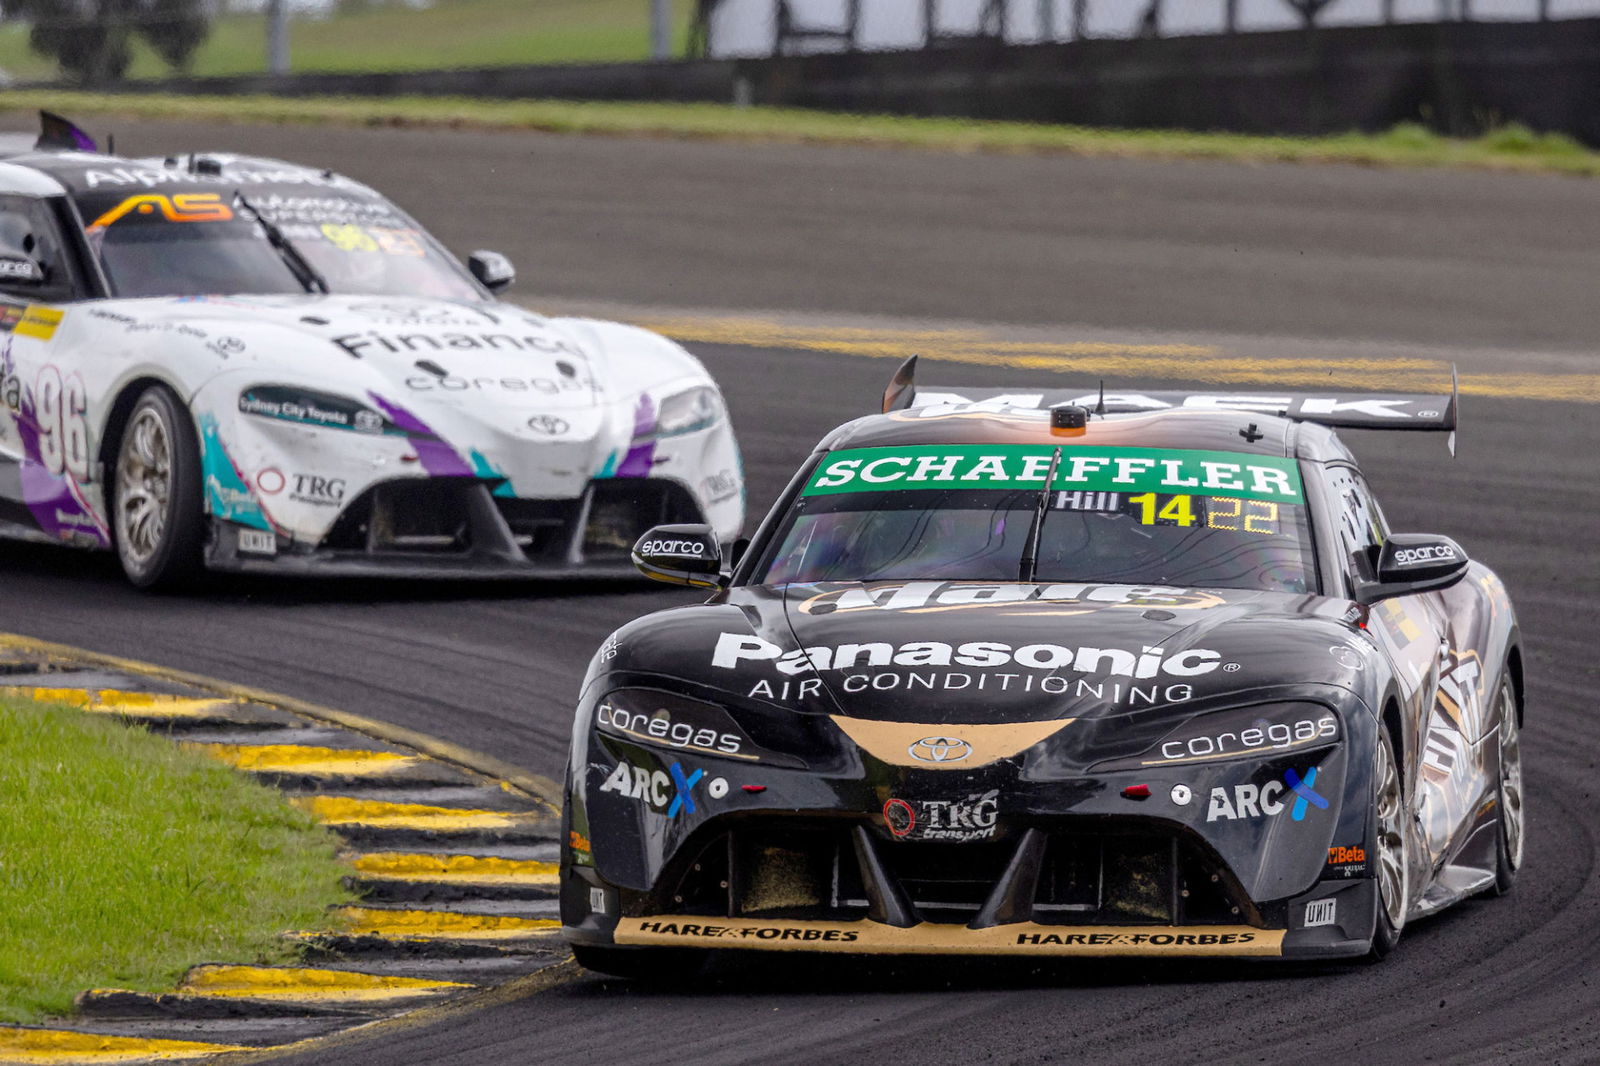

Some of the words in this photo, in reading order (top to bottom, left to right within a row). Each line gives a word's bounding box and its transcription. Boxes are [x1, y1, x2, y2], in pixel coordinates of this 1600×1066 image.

[36, 364, 89, 483] 96
[239, 396, 280, 415] Sydney
[282, 400, 306, 419] City
[307, 405, 348, 424] Toyota
[293, 473, 346, 499] TRG
[814, 454, 1297, 497] SCHAEFFLER
[1055, 490, 1119, 511] Hill
[1129, 492, 1196, 527] 14
[1207, 496, 1279, 535] 22
[642, 538, 704, 557] sparco
[1394, 545, 1455, 565] sparco
[711, 631, 1223, 680] Panasonic
[748, 678, 825, 701] AIR
[843, 671, 1193, 705] CONDITIONING
[597, 703, 742, 754] coregas
[1161, 716, 1337, 760] coregas
[923, 797, 999, 829] TRG
[1338, 845, 1366, 863] Beta
